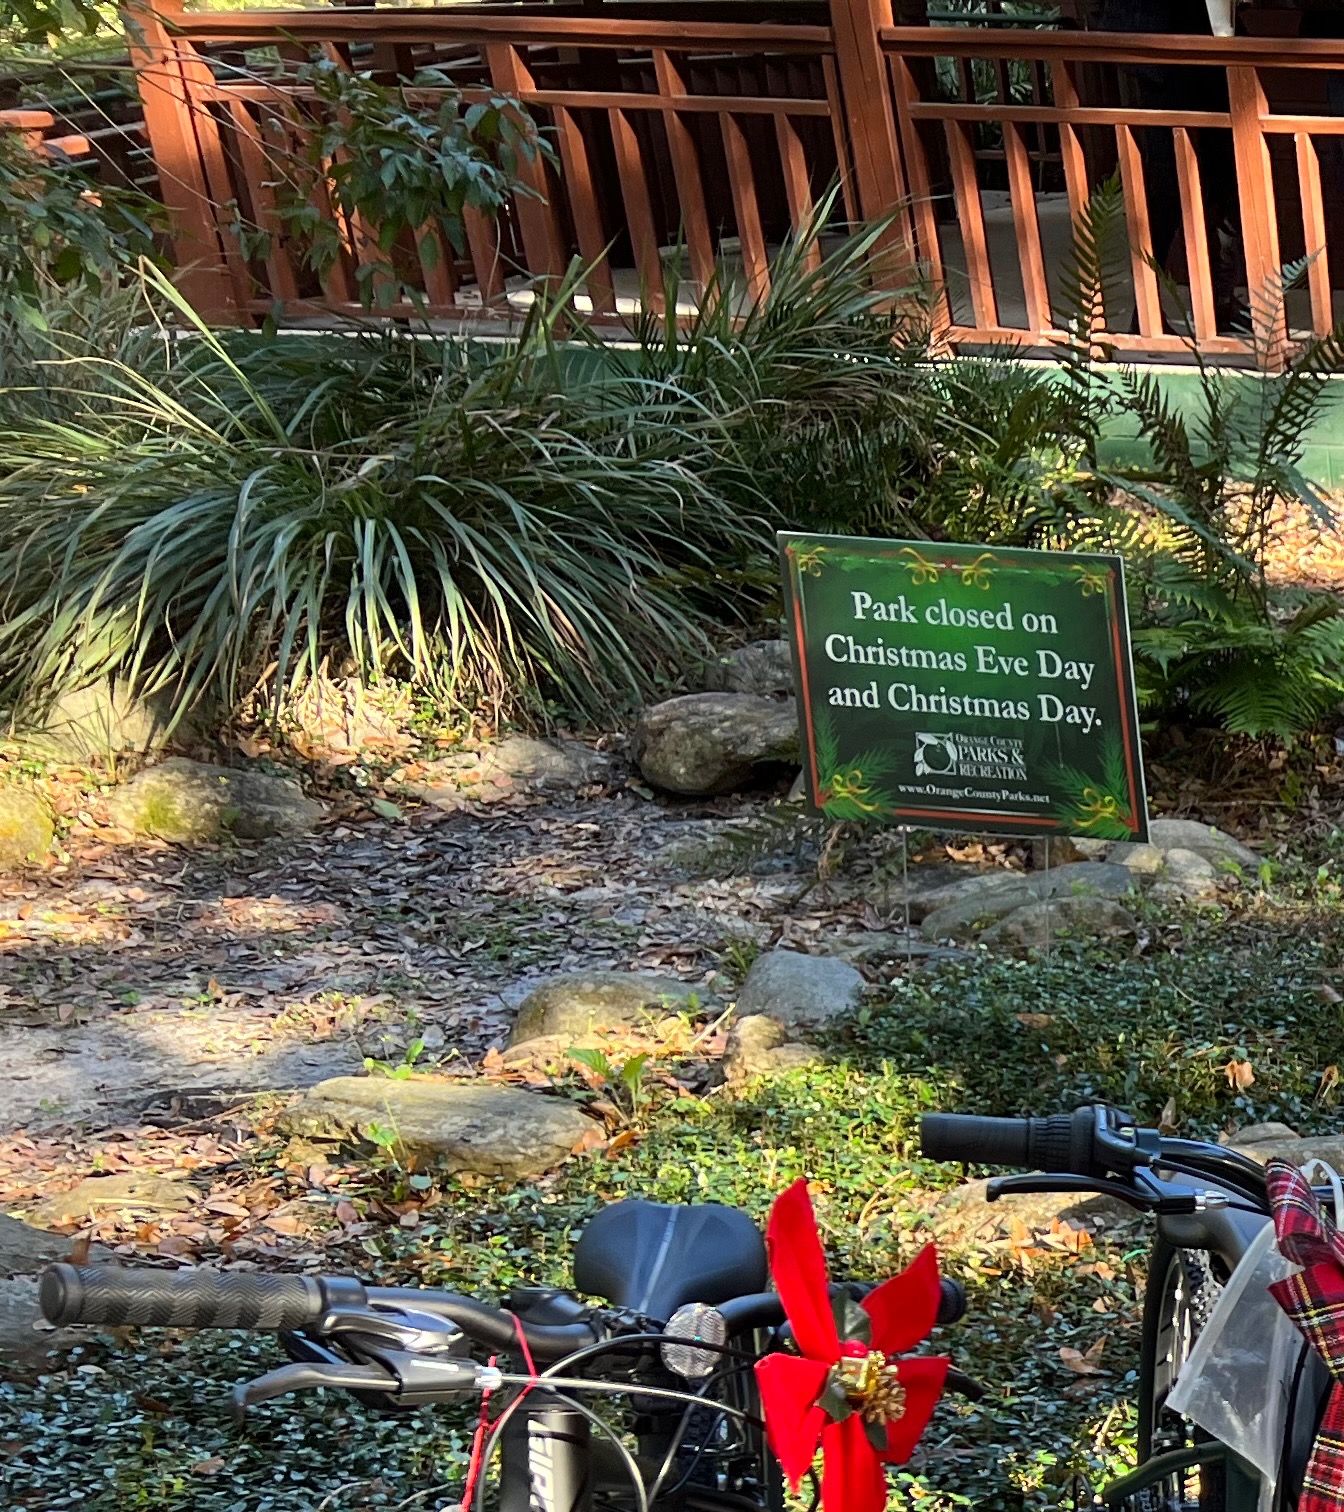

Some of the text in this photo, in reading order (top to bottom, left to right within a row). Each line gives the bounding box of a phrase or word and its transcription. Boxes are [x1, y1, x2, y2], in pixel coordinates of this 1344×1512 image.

[850, 591, 1059, 635] Park closed on
[824, 633, 1096, 691] Christmas Eve Day
[828, 681, 1102, 734] and Christmas Day.
[957, 745, 1025, 766] PARKS &
[958, 763, 1028, 781] RECREATION
[898, 783, 1050, 803] www.OrangeCountyParks.net
